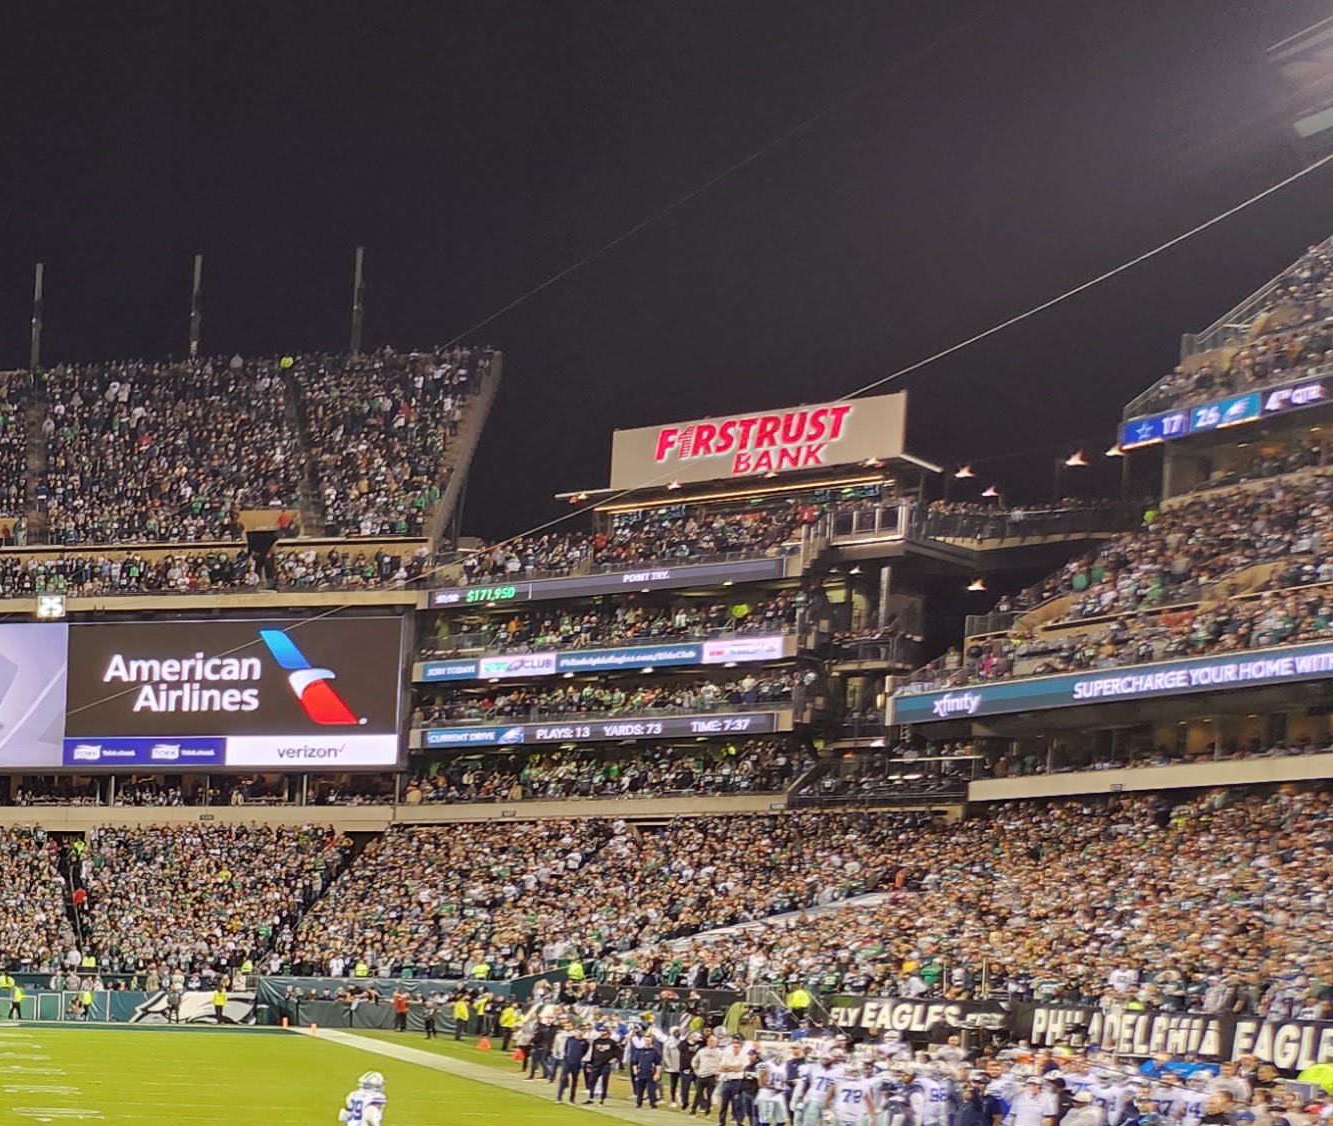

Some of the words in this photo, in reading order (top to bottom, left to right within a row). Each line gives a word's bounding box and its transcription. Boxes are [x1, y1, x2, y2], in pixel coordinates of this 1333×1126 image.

[1162, 414, 1183, 436] 17
[1196, 405, 1222, 428] 26
[732, 442, 829, 475] BANK
[466, 586, 517, 603] $171,950
[39, 598, 64, 618] 25
[103, 652, 262, 683] American
[523, 658, 553, 669] CLUB
[133, 683, 260, 712] Airlines
[934, 691, 981, 718] xfinity
[1073, 668, 1188, 700] SUPERCHARGE
[1188, 663, 1238, 687] YOUR
[1239, 657, 1294, 680] HOME
[536, 726, 574, 740] PLAYS:
[575, 725, 591, 738] 13
[603, 724, 645, 737] YARDS:
[646, 722, 662, 735] 73
[690, 720, 722, 732] TIME:
[722, 718, 751, 732] 7:37
[277, 746, 338, 760] verizon
[828, 1006, 860, 1027] FLY
